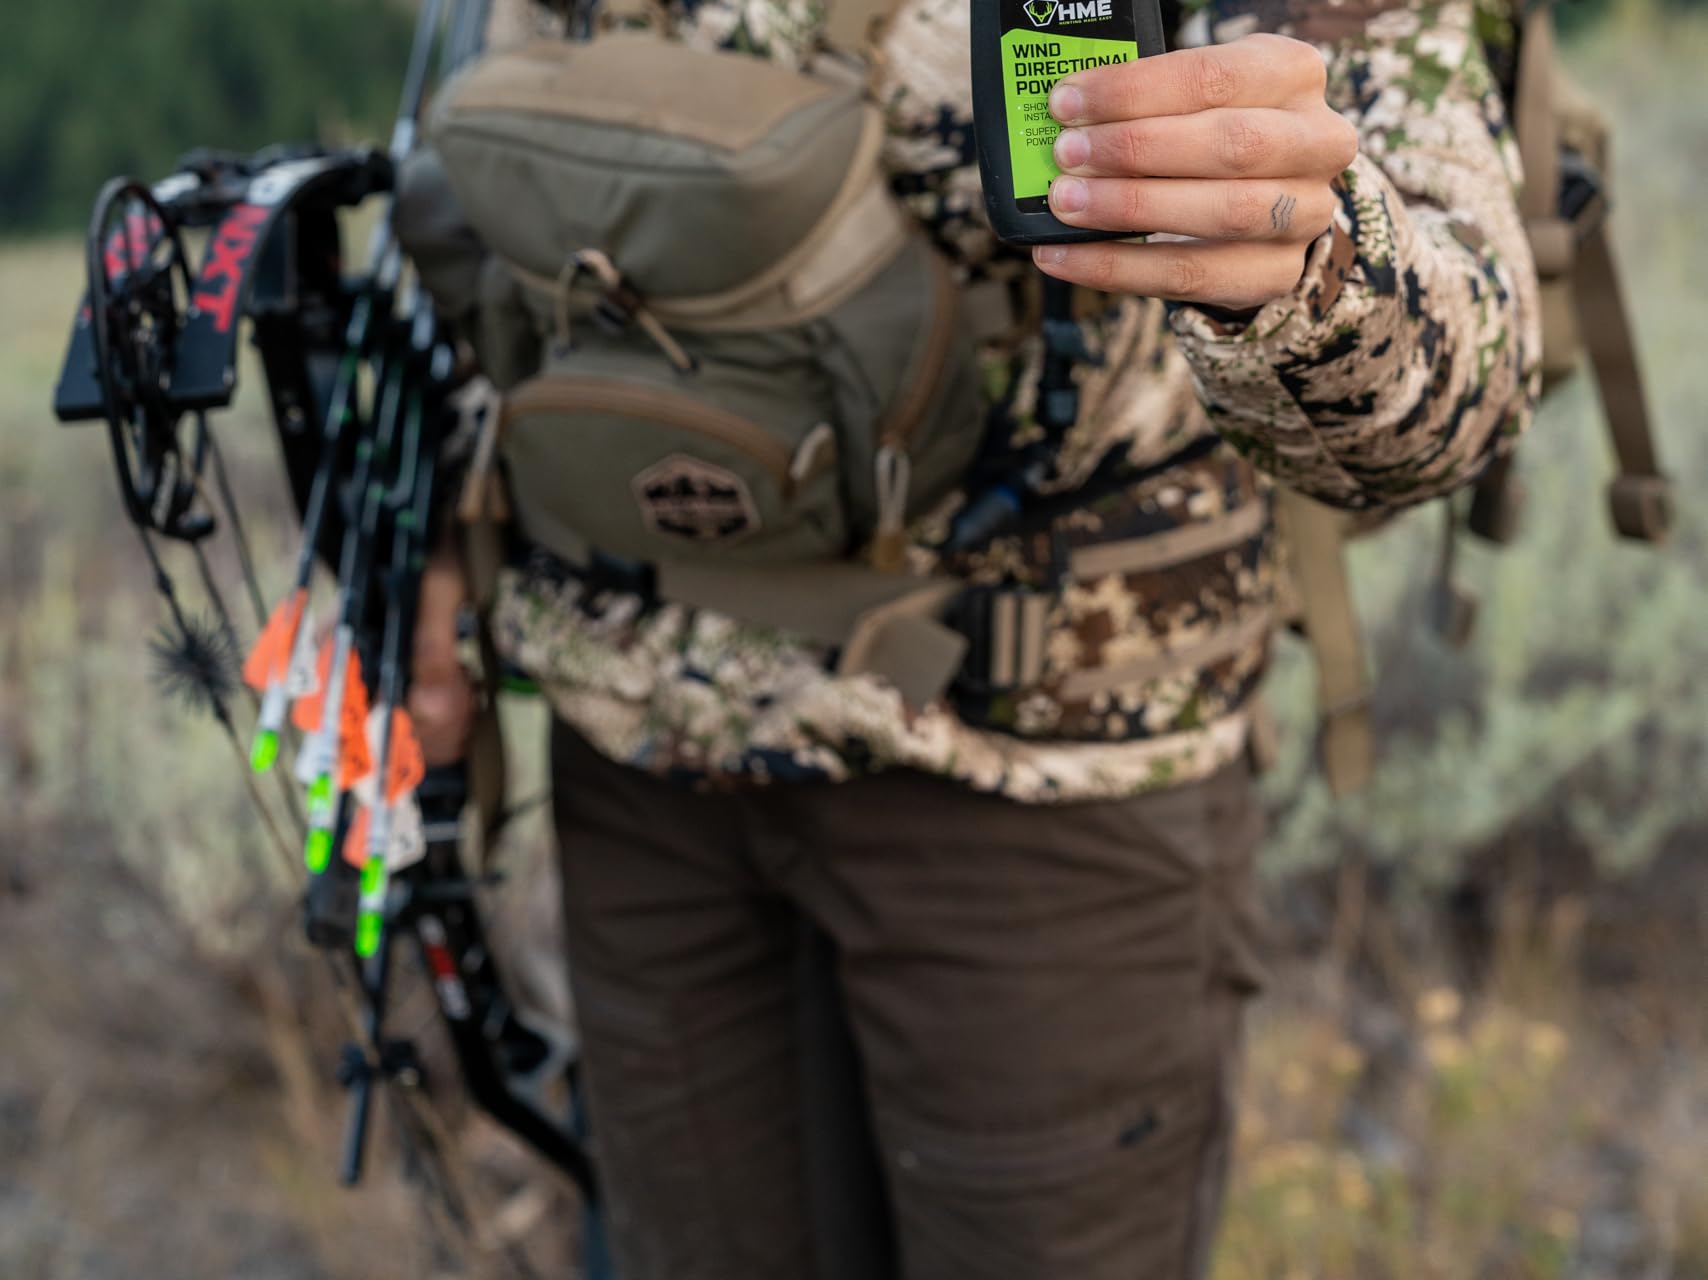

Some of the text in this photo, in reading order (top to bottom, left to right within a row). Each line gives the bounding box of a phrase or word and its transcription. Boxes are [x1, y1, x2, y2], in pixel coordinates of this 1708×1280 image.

[1012, 42, 1061, 58] WIND
[1016, 79, 1060, 95] POW
[1025, 126, 1057, 136] SUPER
[1026, 136, 1057, 146] POWD
